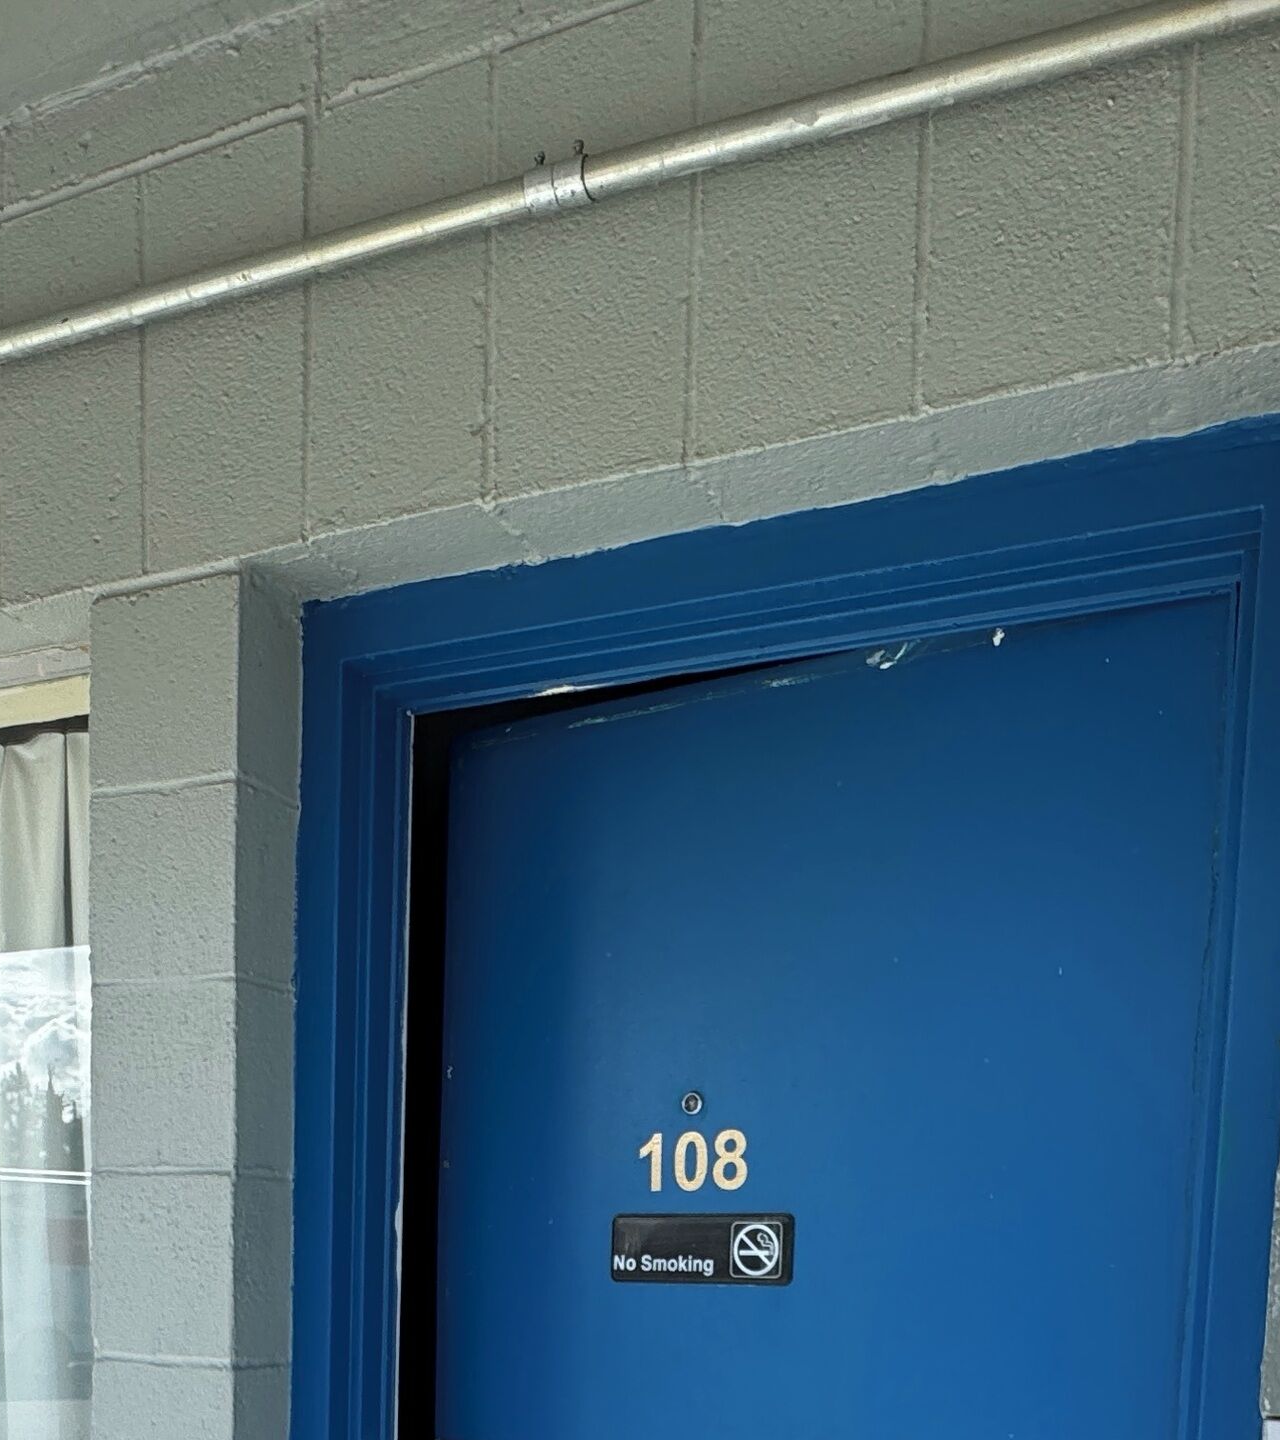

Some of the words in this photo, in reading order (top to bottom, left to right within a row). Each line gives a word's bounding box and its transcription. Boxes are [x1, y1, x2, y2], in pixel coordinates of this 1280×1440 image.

[639, 1129, 748, 1192] 108
[613, 1254, 637, 1271] No
[640, 1254, 714, 1276] Smoking
